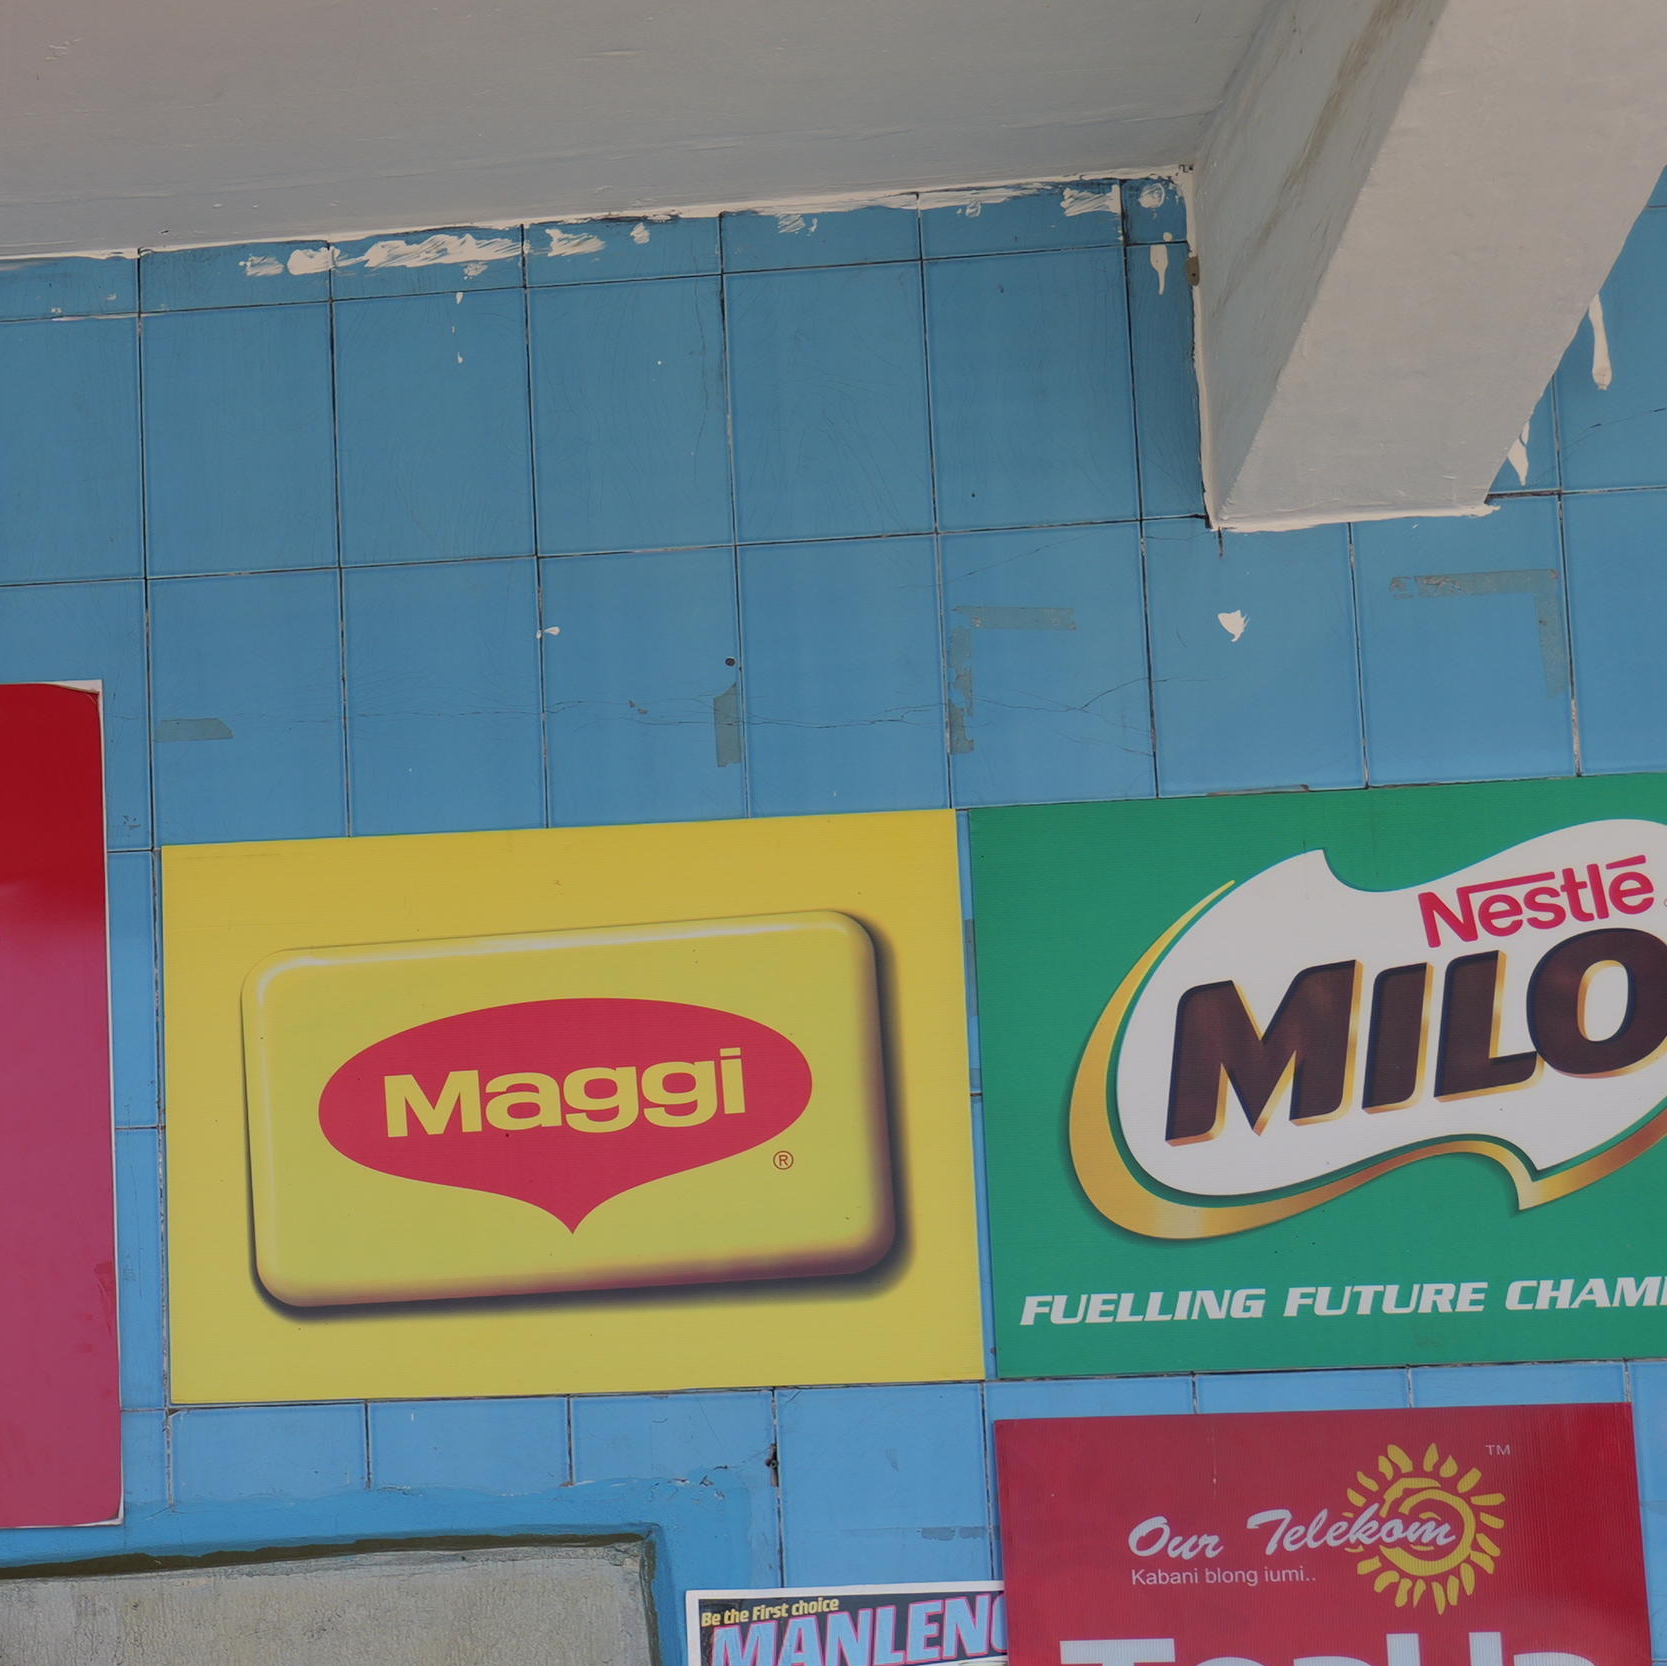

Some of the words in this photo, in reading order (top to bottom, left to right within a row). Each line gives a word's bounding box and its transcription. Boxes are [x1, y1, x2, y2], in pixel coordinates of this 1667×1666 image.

[1164, 928, 1667, 1147] MILO
[382, 1047, 749, 1139] Maggi
[1020, 1286, 1265, 1326] FUELLING
[1283, 1281, 1488, 1318] FUTURE
[1128, 1516, 1222, 1560] Our
[1246, 1503, 1455, 1555] Telekom
[1131, 1568, 1199, 1585] Kabani
[1206, 1566, 1258, 1587] blong
[701, 1612, 721, 1627] Be
[724, 1609, 748, 1625] the
[752, 1603, 789, 1622] First
[792, 1597, 839, 1618] choice
